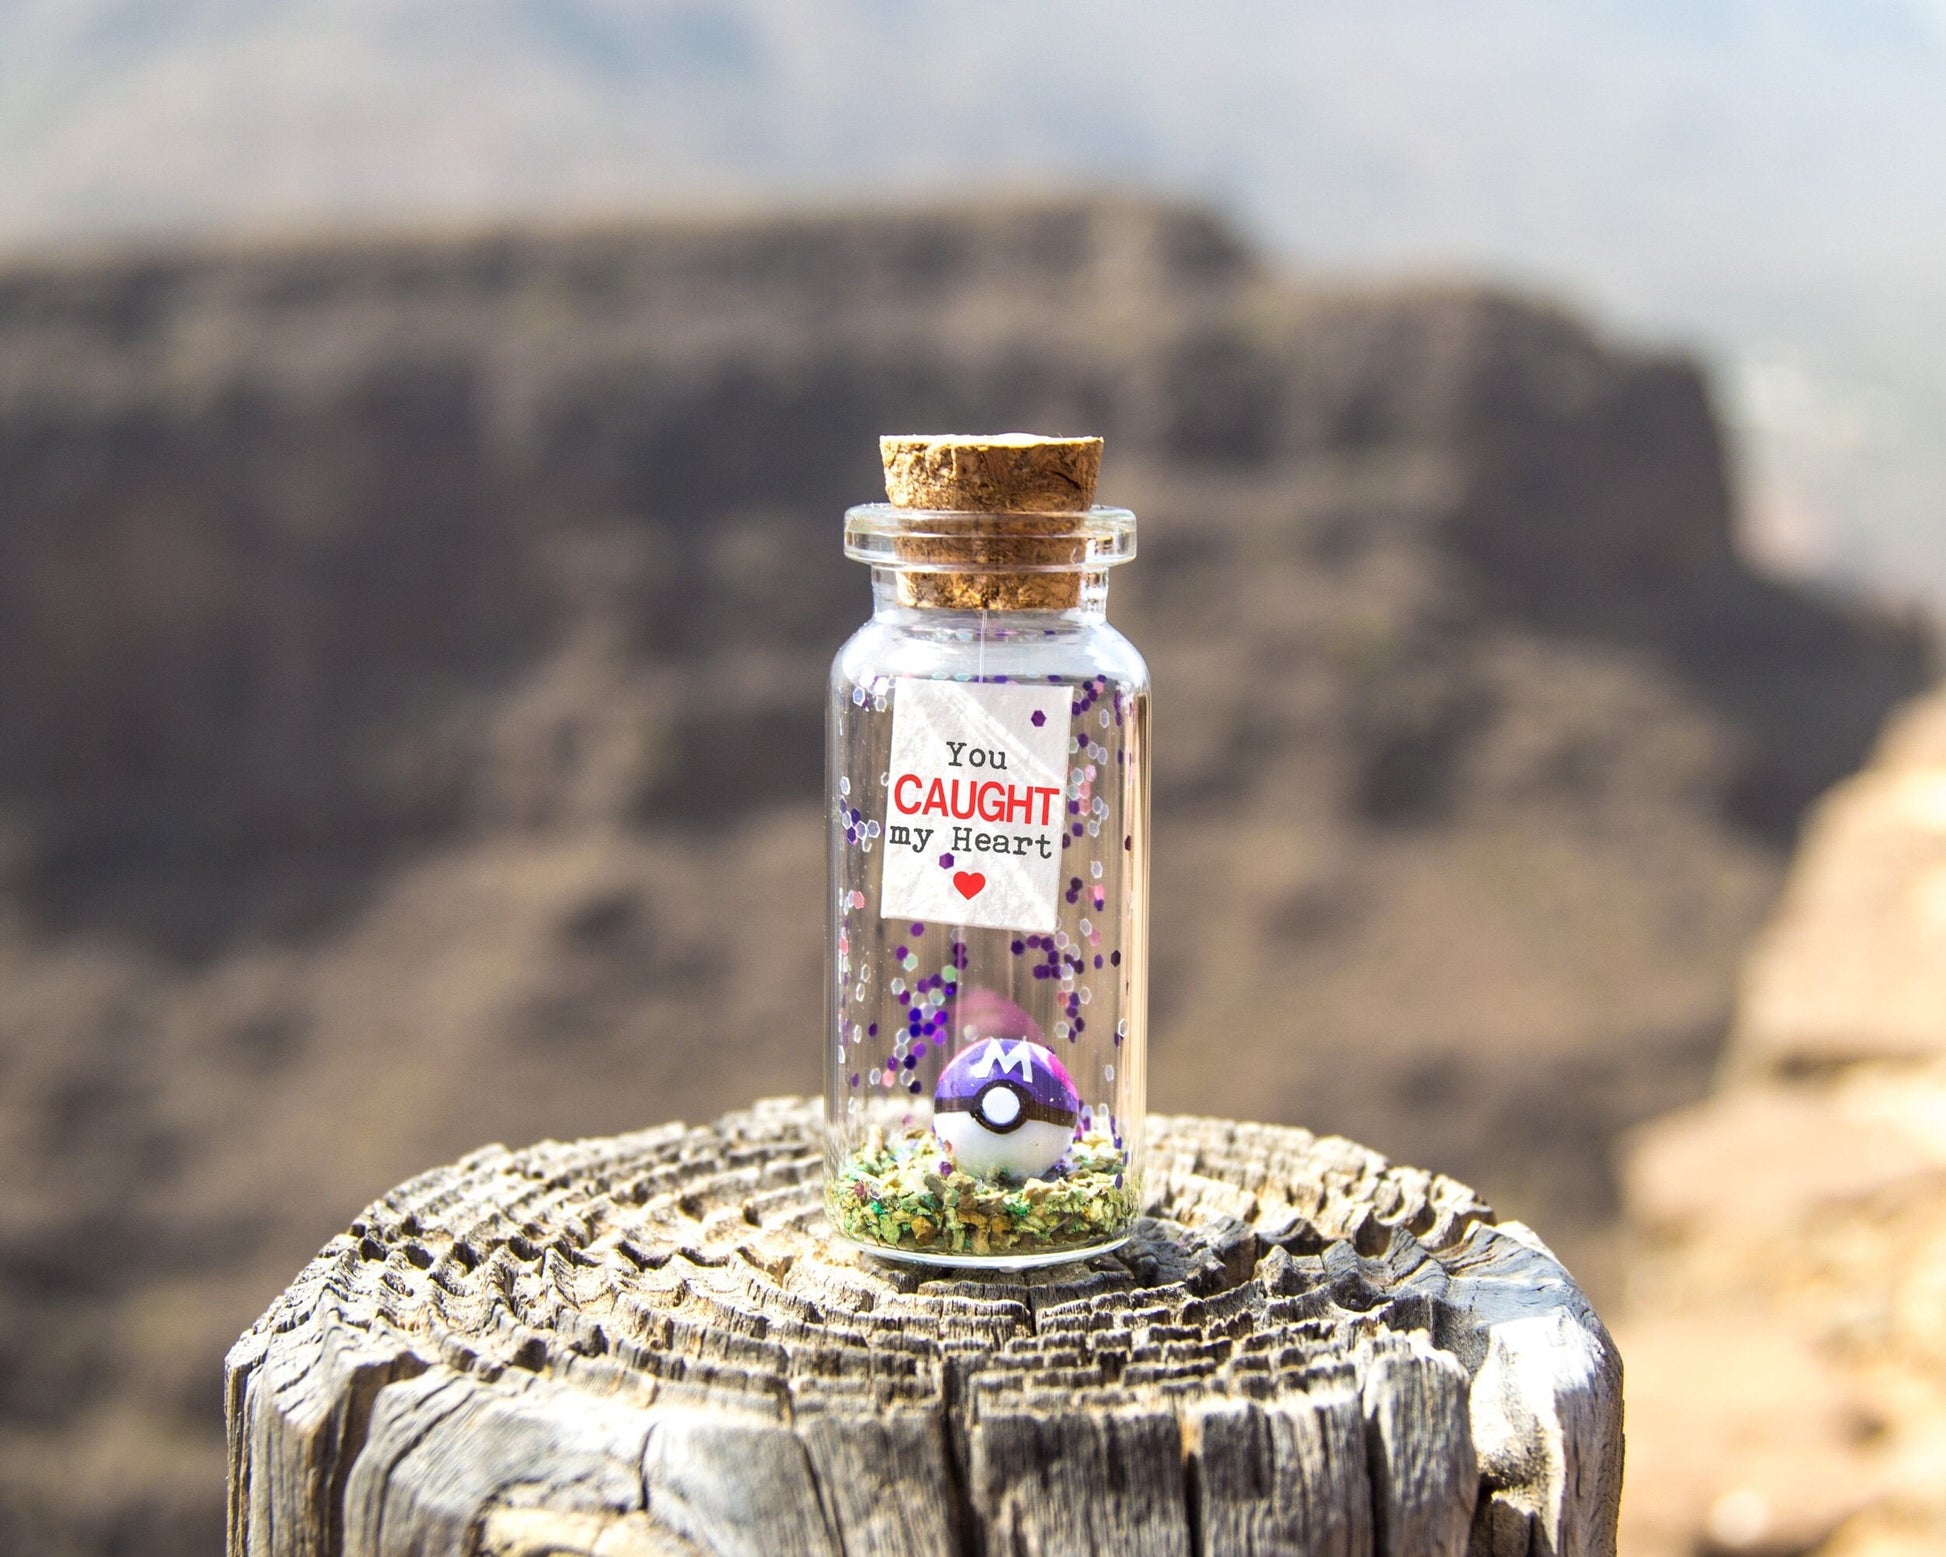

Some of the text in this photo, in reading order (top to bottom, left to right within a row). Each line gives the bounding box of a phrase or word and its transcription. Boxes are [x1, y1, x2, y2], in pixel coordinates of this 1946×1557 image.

[946, 741, 1007, 770] You
[894, 773, 1060, 826] CAUGHT
[889, 825, 1052, 859] my Heart
[970, 1036, 1033, 1083] M
